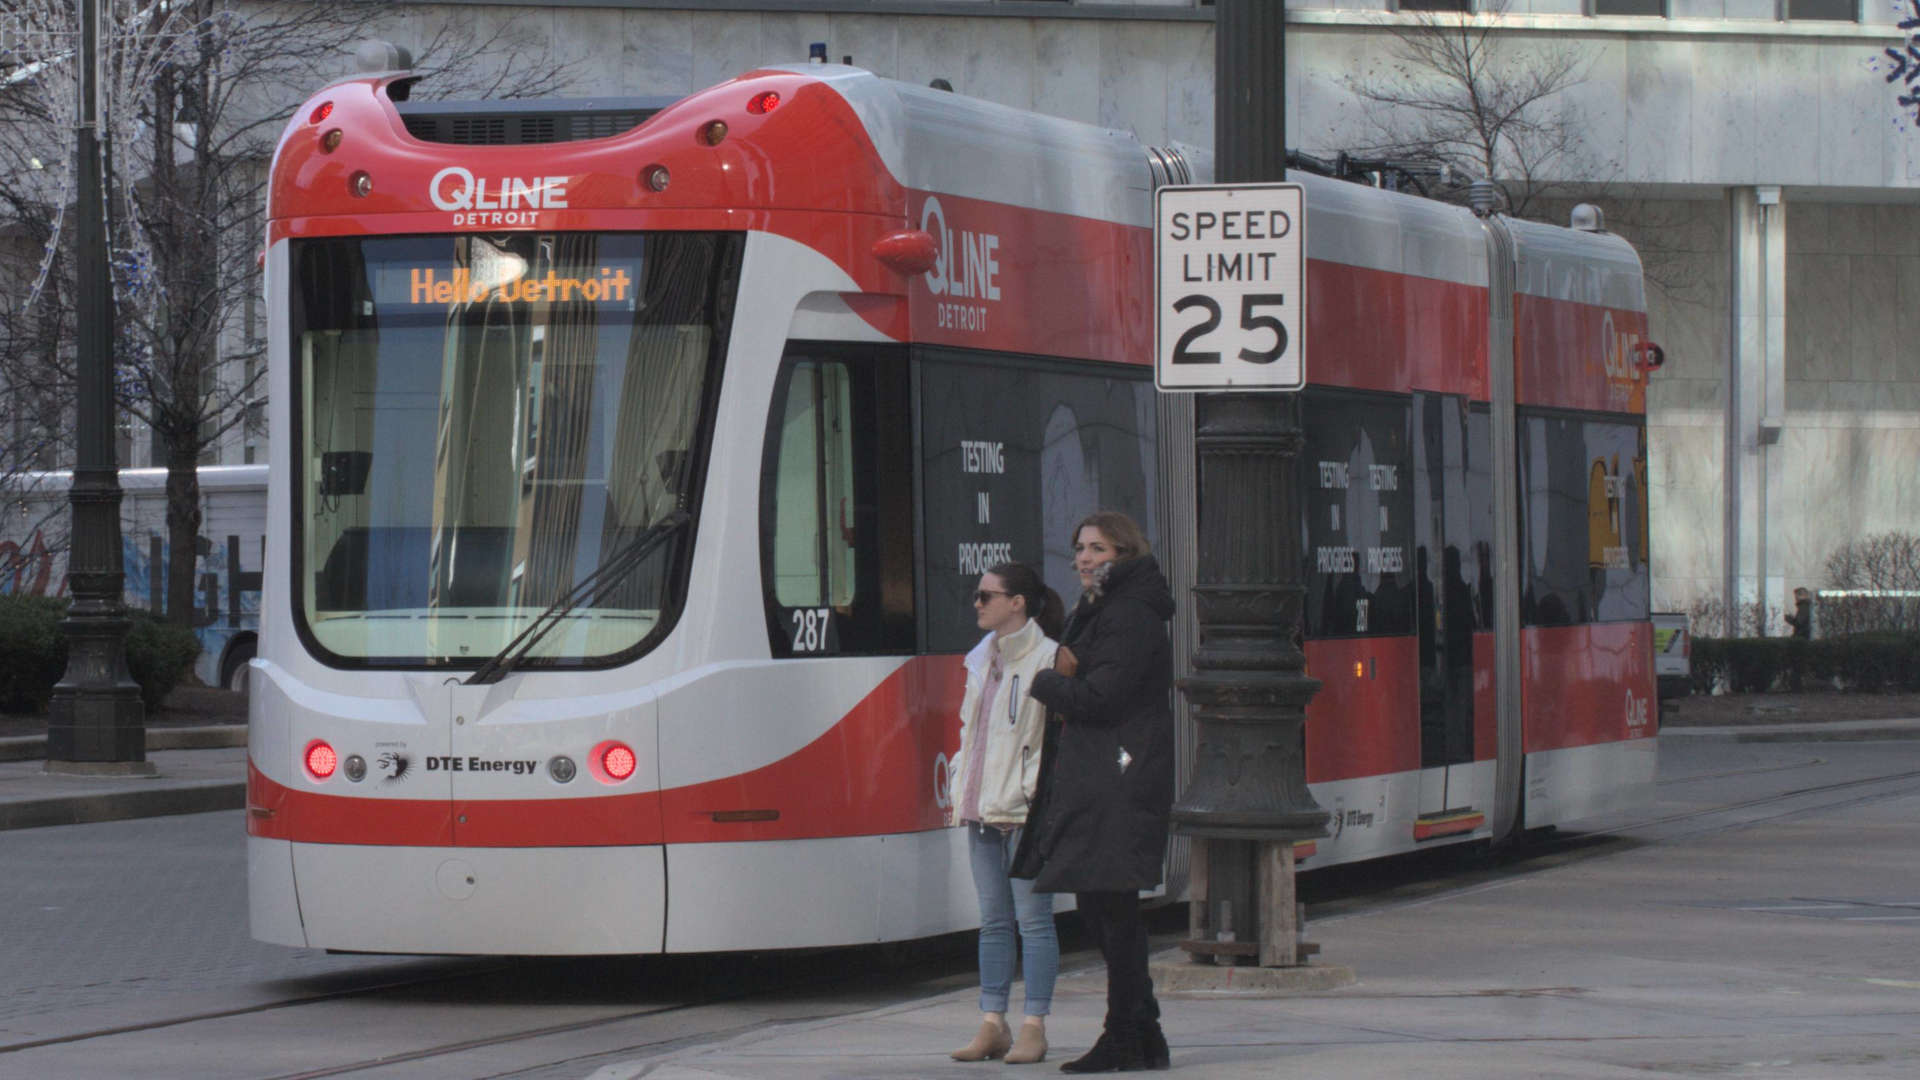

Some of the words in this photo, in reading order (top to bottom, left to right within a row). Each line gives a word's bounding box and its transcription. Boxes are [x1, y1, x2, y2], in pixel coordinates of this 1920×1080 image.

[429, 166, 570, 212] QLINE
[453, 211, 540, 226] DETROIT
[1170, 210, 1291, 241] SPEED
[919, 195, 1001, 301] QLINE
[1182, 252, 1277, 282] LIMIT
[410, 268, 489, 304] Hello
[503, 268, 632, 302] Detroit
[937, 303, 988, 333] DETROIT
[1171, 293, 1289, 365] 25
[961, 440, 1005, 475] TESTING
[1318, 461, 1350, 489] TESTING
[1368, 464, 1398, 491] TESTING
[977, 491, 990, 524] IN
[1317, 546, 1355, 574] PROGRESS
[1367, 546, 1403, 574] PROGRESS
[792, 607, 831, 652] 287
[426, 756, 463, 772] DTE
[468, 756, 538, 775] Energy
